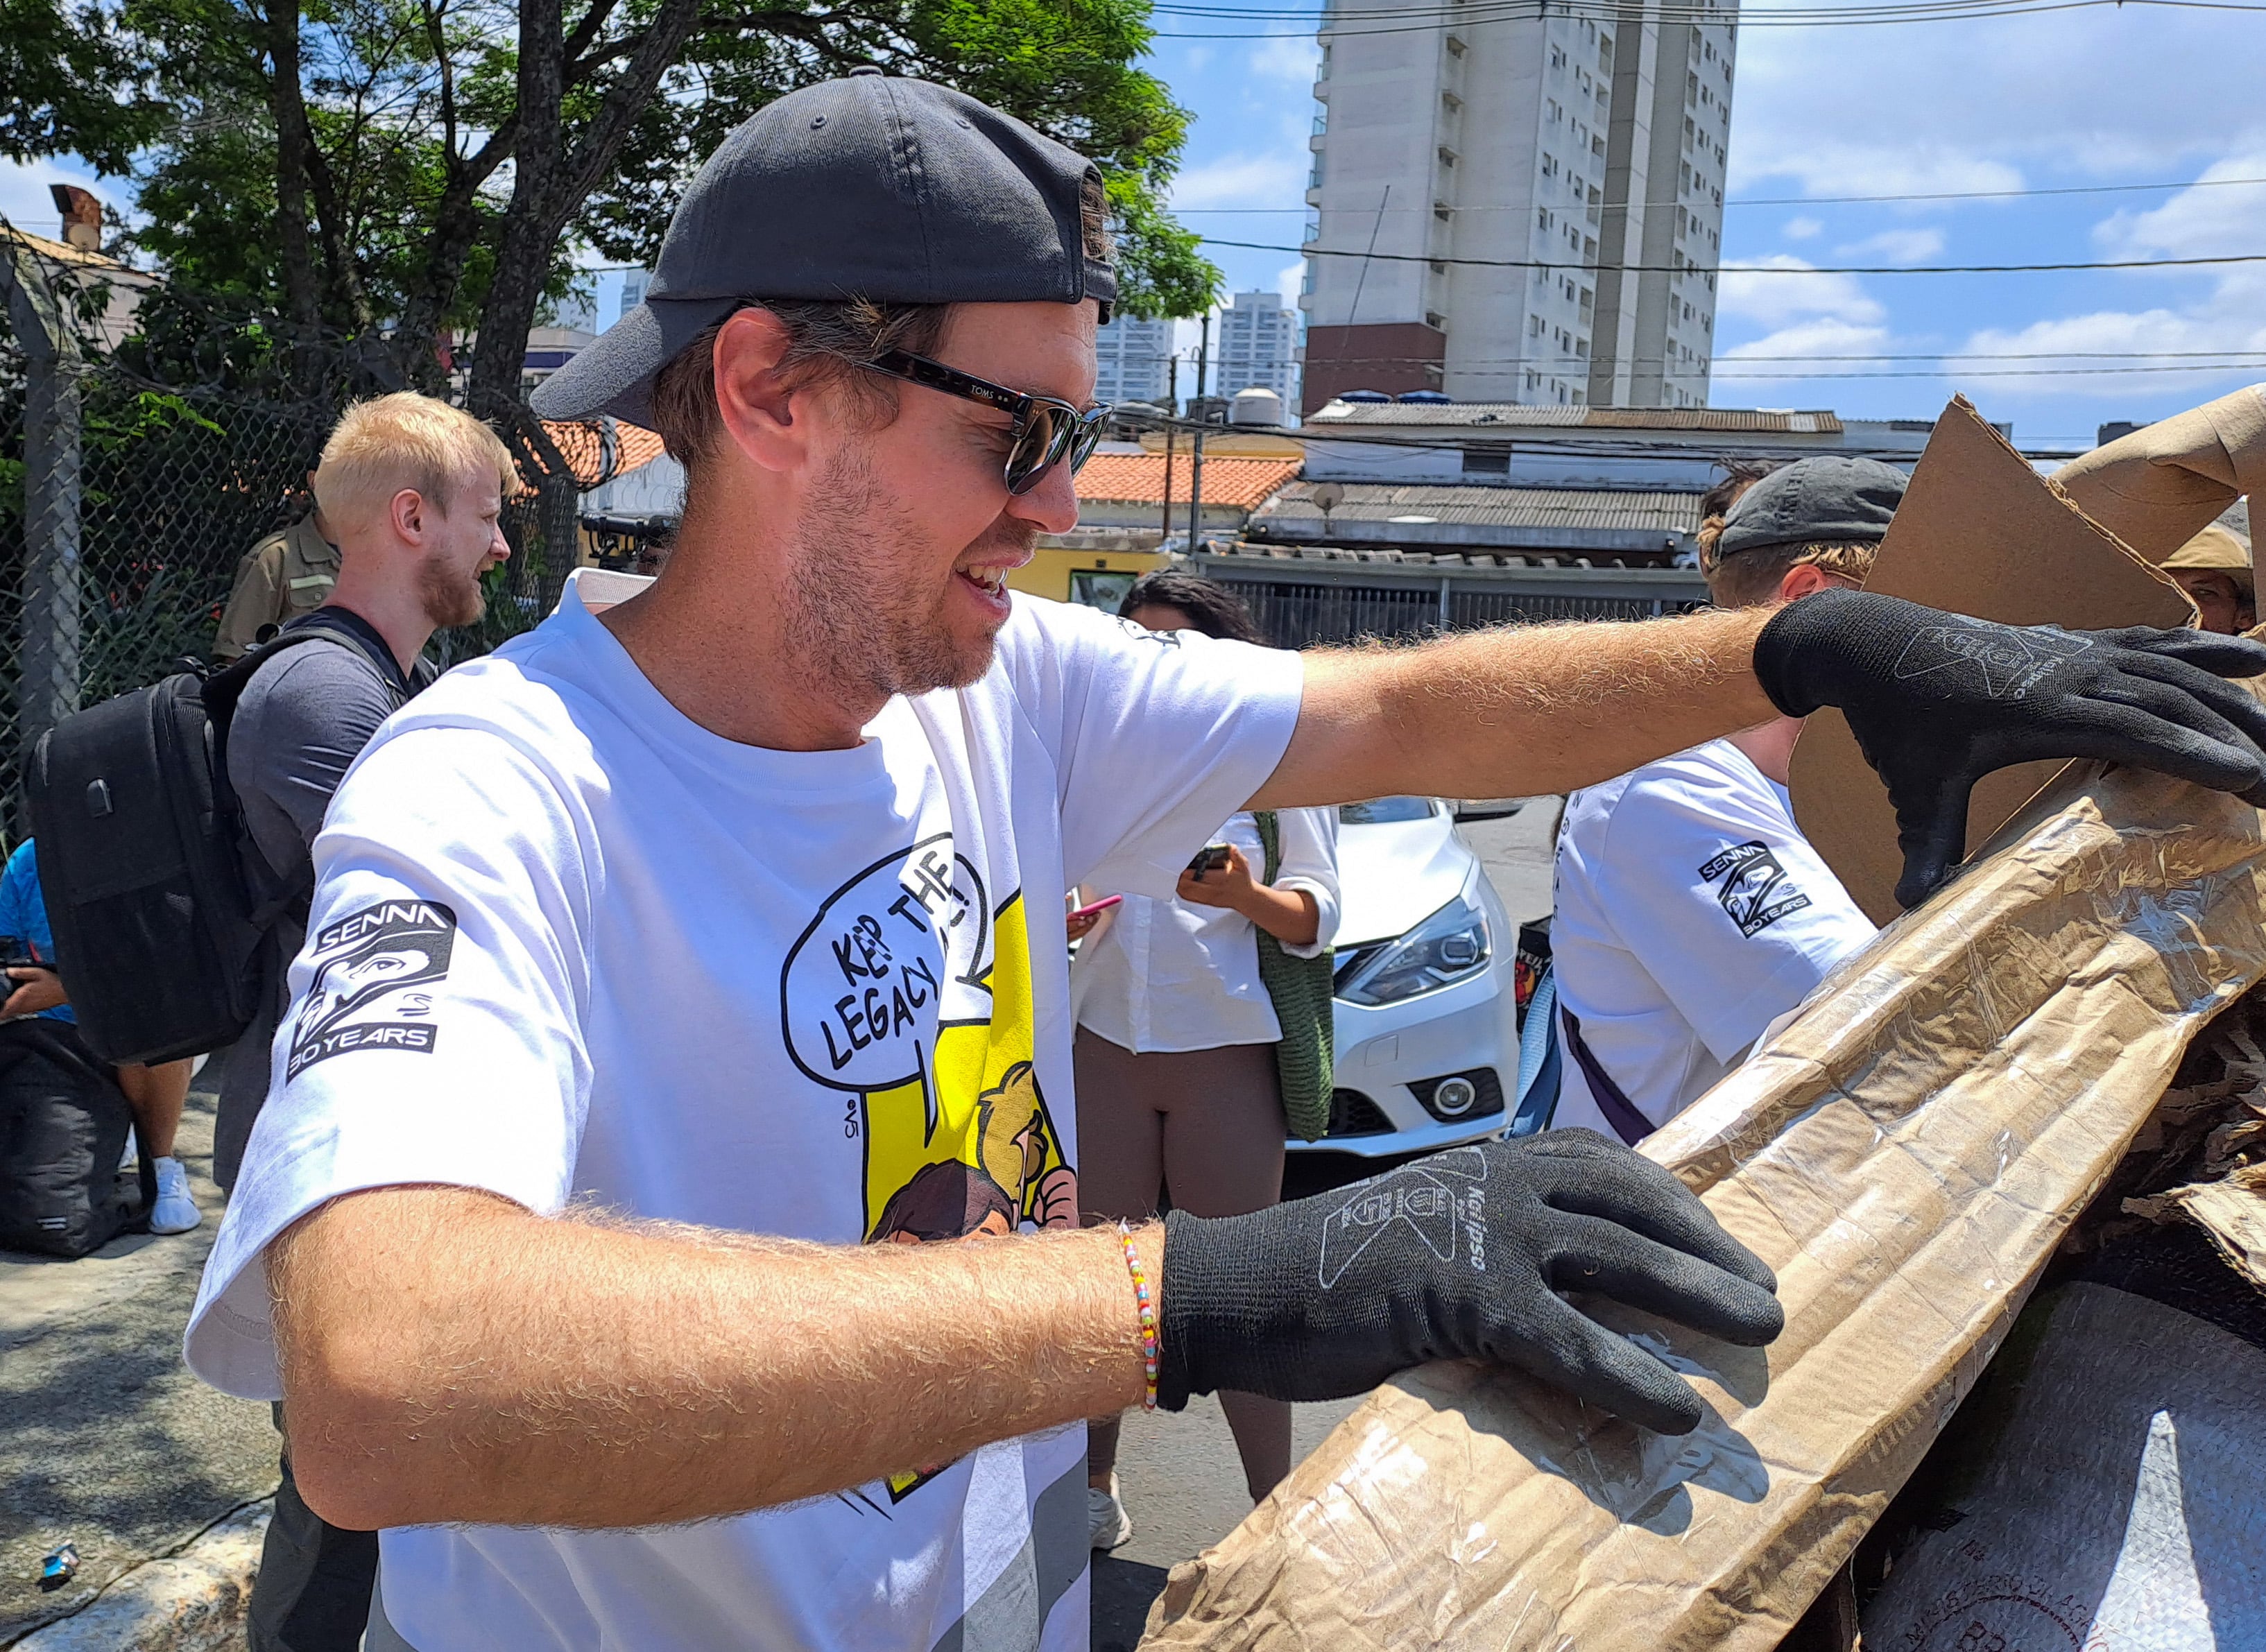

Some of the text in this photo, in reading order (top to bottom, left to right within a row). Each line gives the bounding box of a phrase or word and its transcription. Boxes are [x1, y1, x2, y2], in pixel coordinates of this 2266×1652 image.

[970, 384, 994, 400] TOMS
[1703, 845, 1767, 879] SENNA
[318, 904, 449, 953] SENNA
[832, 914, 893, 987] KEP
[888, 850, 954, 933] THE
[1743, 897, 1808, 936] 30 YEARS
[820, 956, 938, 1071] LEGACY
[289, 1027, 429, 1076] 30 YEARS
